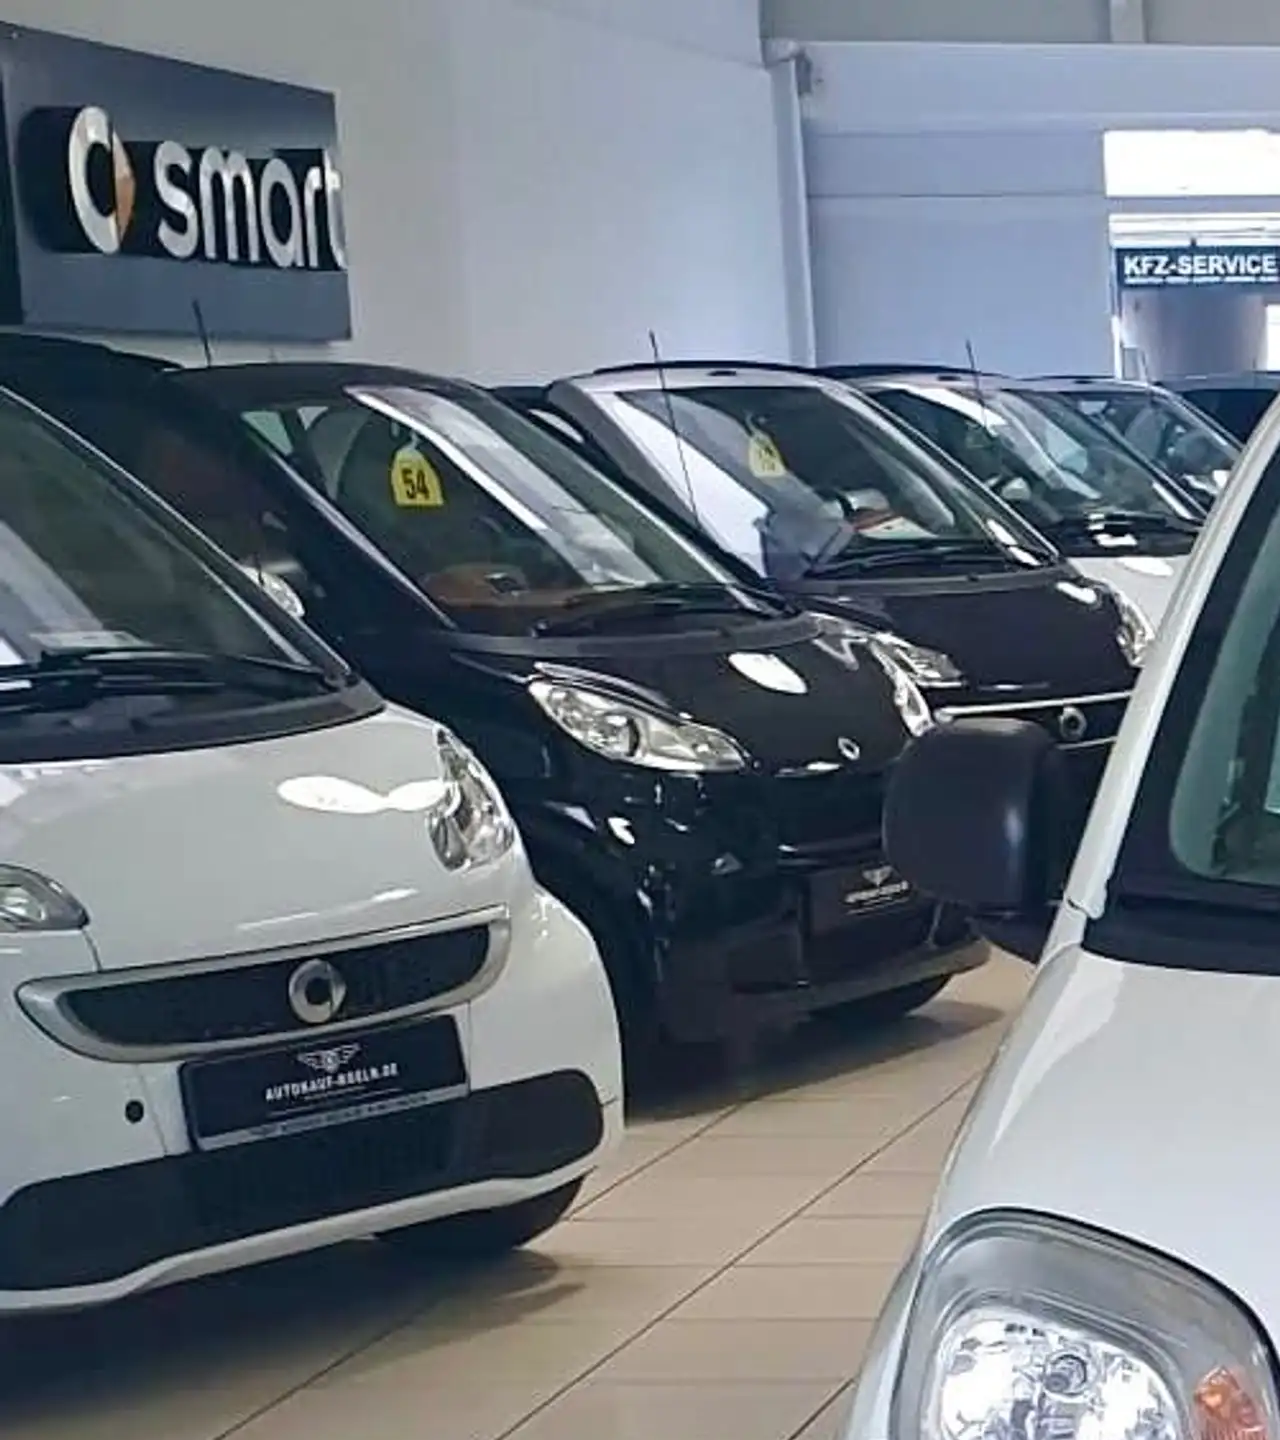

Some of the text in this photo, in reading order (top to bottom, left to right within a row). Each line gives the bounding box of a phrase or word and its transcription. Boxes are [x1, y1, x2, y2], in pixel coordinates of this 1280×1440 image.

[154, 140, 347, 268] smart
[1123, 254, 1279, 275] KFZ-SERVICE
[402, 468, 430, 499] 54
